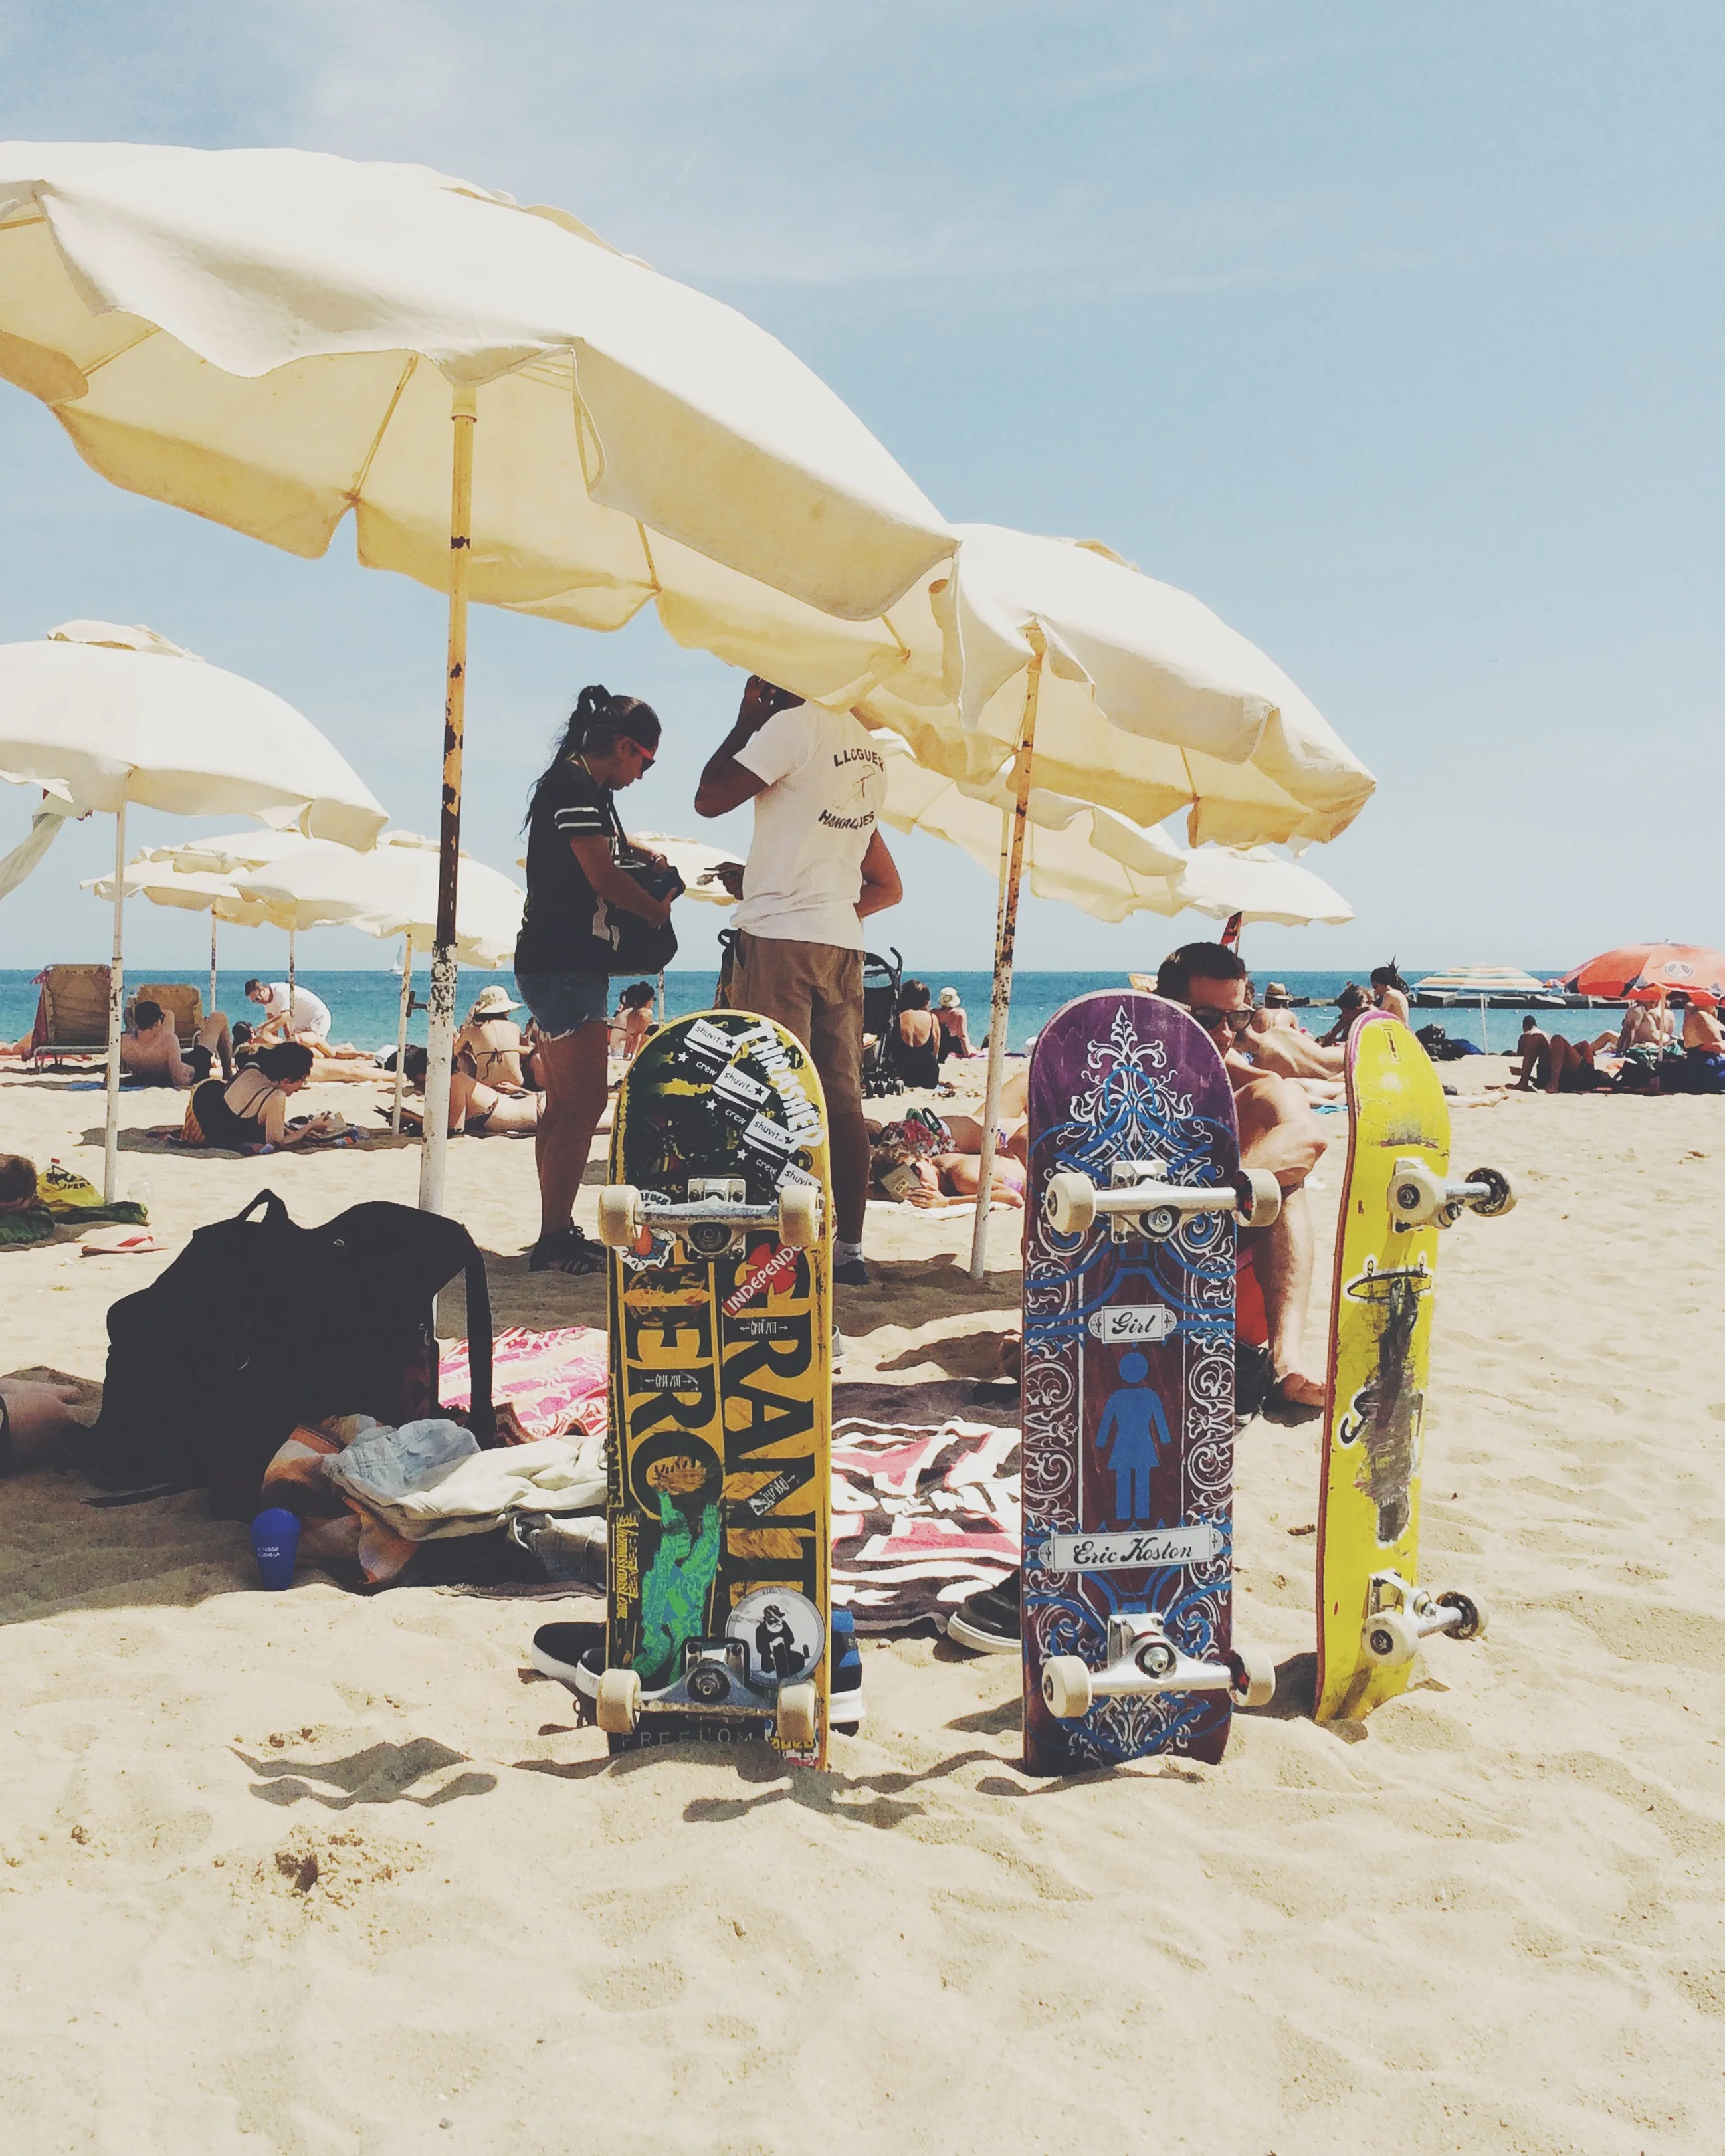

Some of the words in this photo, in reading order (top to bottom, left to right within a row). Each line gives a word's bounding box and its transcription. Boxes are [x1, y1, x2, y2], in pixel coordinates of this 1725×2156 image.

[696, 1061, 718, 1077] crew
[725, 1108, 747, 1125] crew
[756, 1158, 778, 1175] crew
[1110, 1312, 1154, 1335] Girl
[1072, 1540, 1118, 1565] Eric
[1119, 1536, 1195, 1563] Koston
[621, 1727, 754, 1749] FREEDOM
